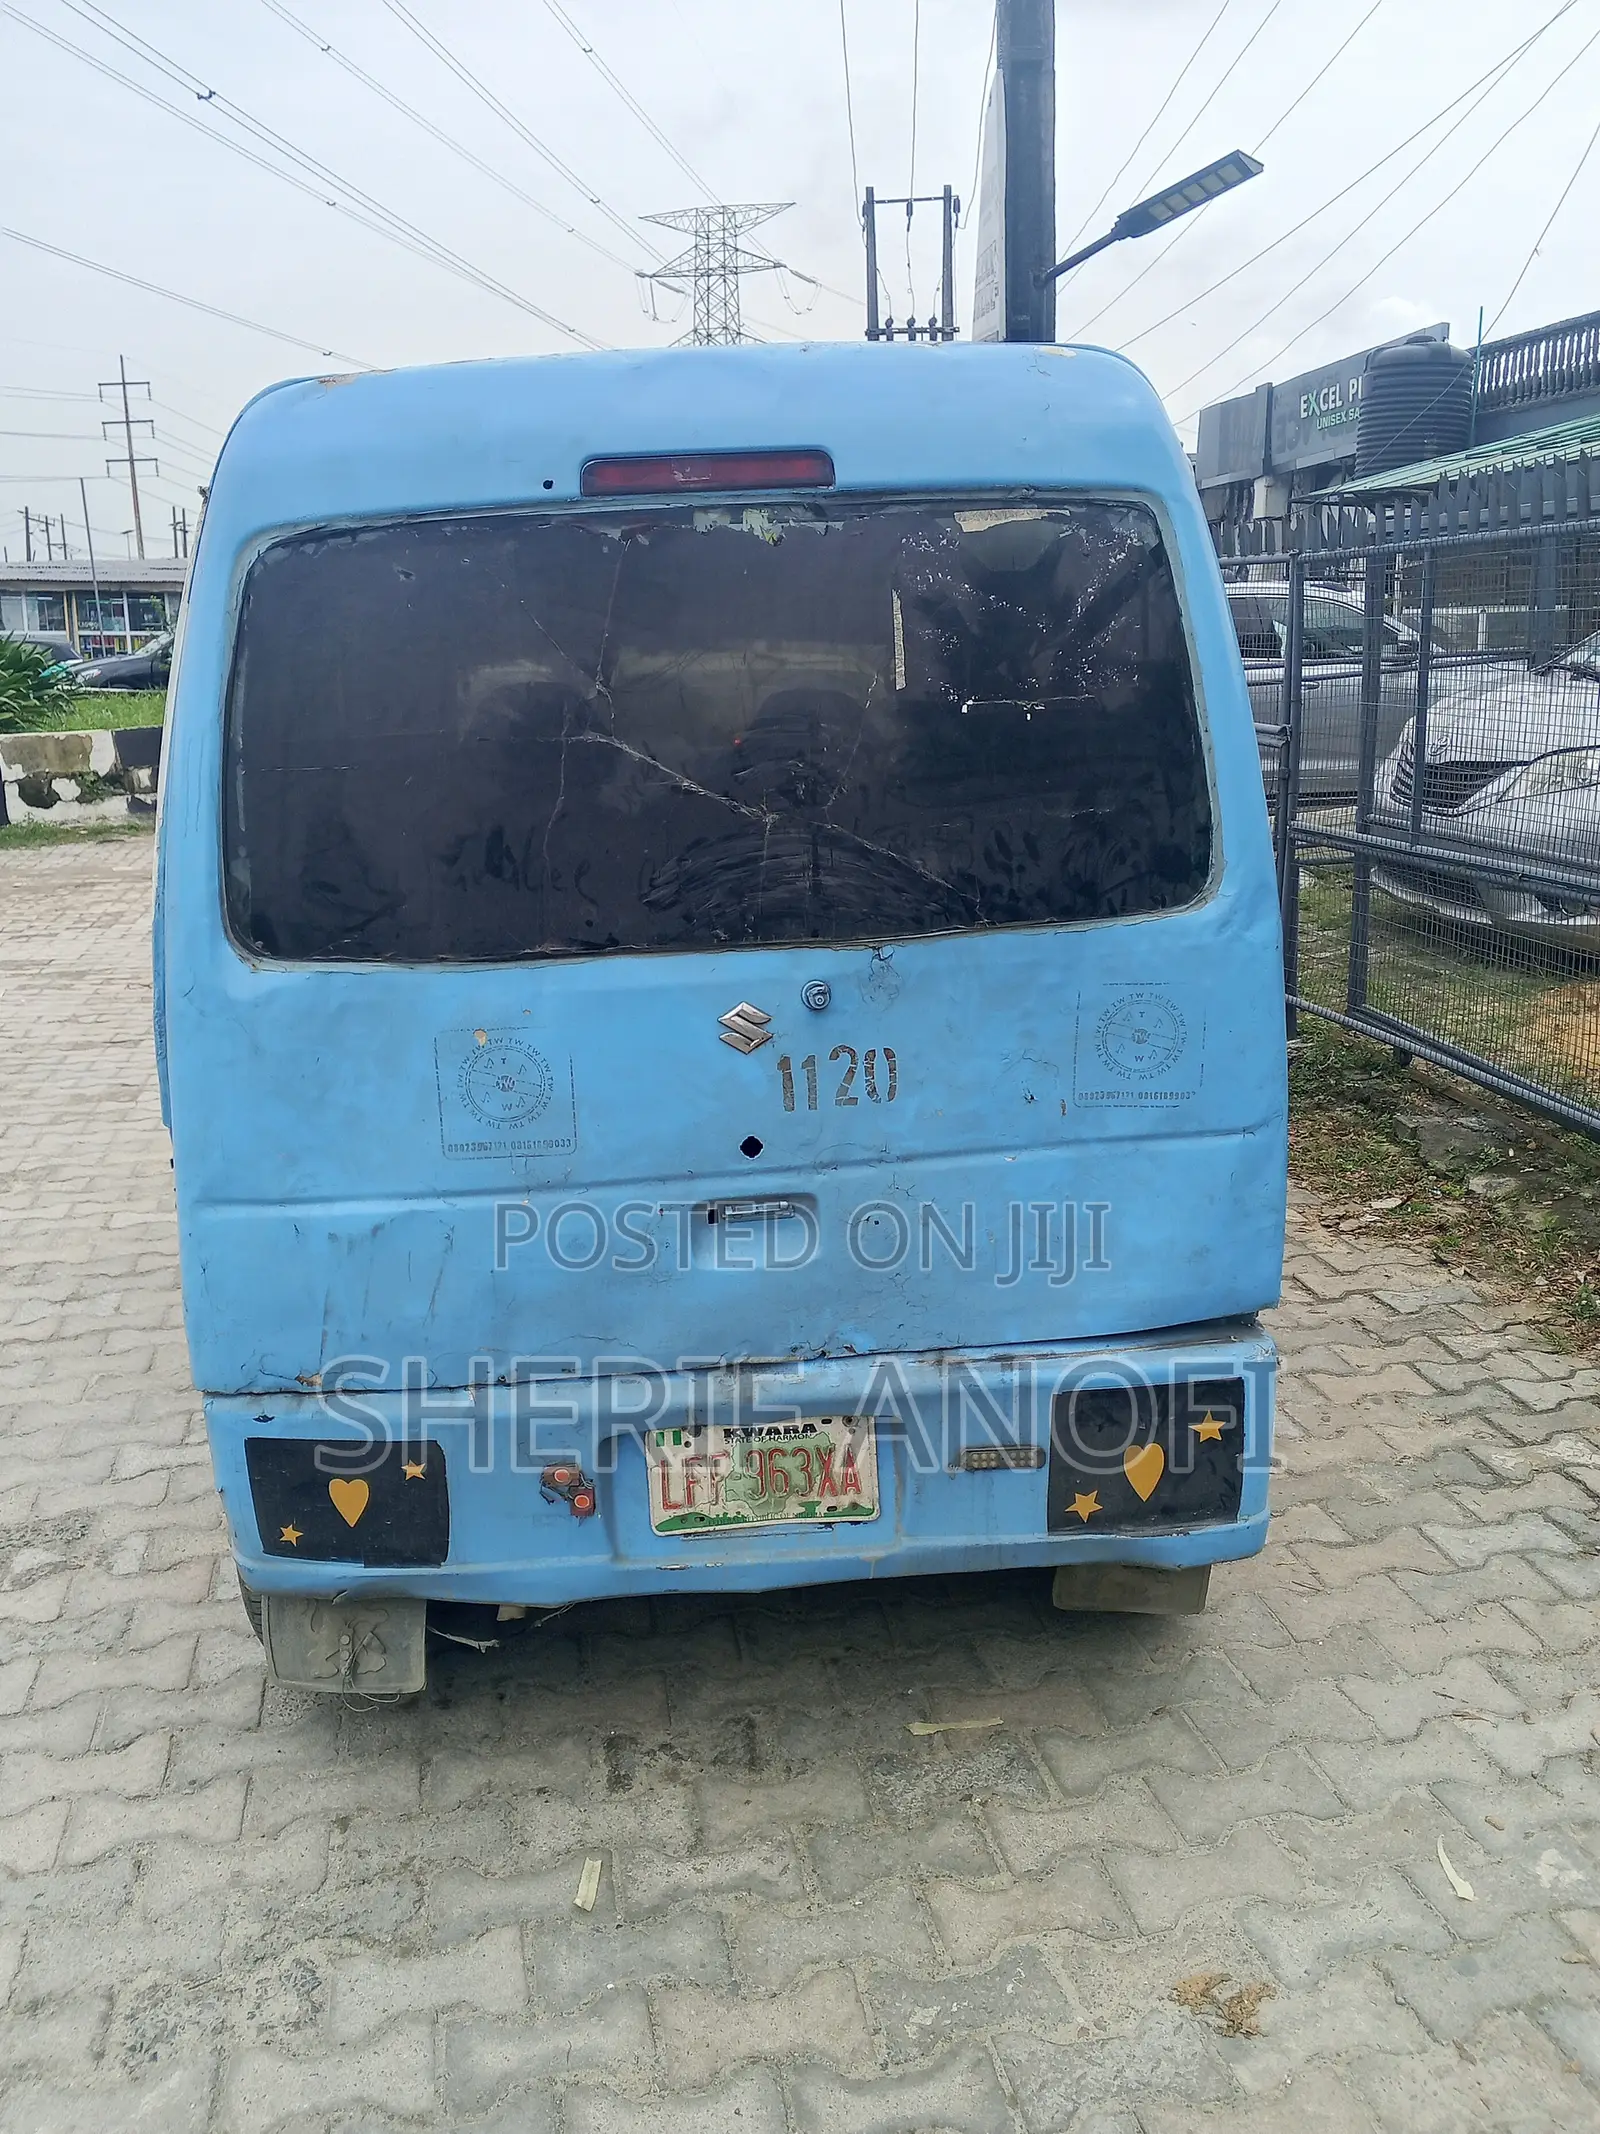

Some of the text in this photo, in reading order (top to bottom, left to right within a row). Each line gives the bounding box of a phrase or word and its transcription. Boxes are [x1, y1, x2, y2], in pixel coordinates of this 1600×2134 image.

[1300, 382, 1343, 419] EXCEL
[1316, 410, 1347, 430] UNISEX
[776, 1044, 899, 1113] 1120
[723, 1423, 818, 1438] KWARA
[724, 1433, 813, 1444] STATE OF HARMON
